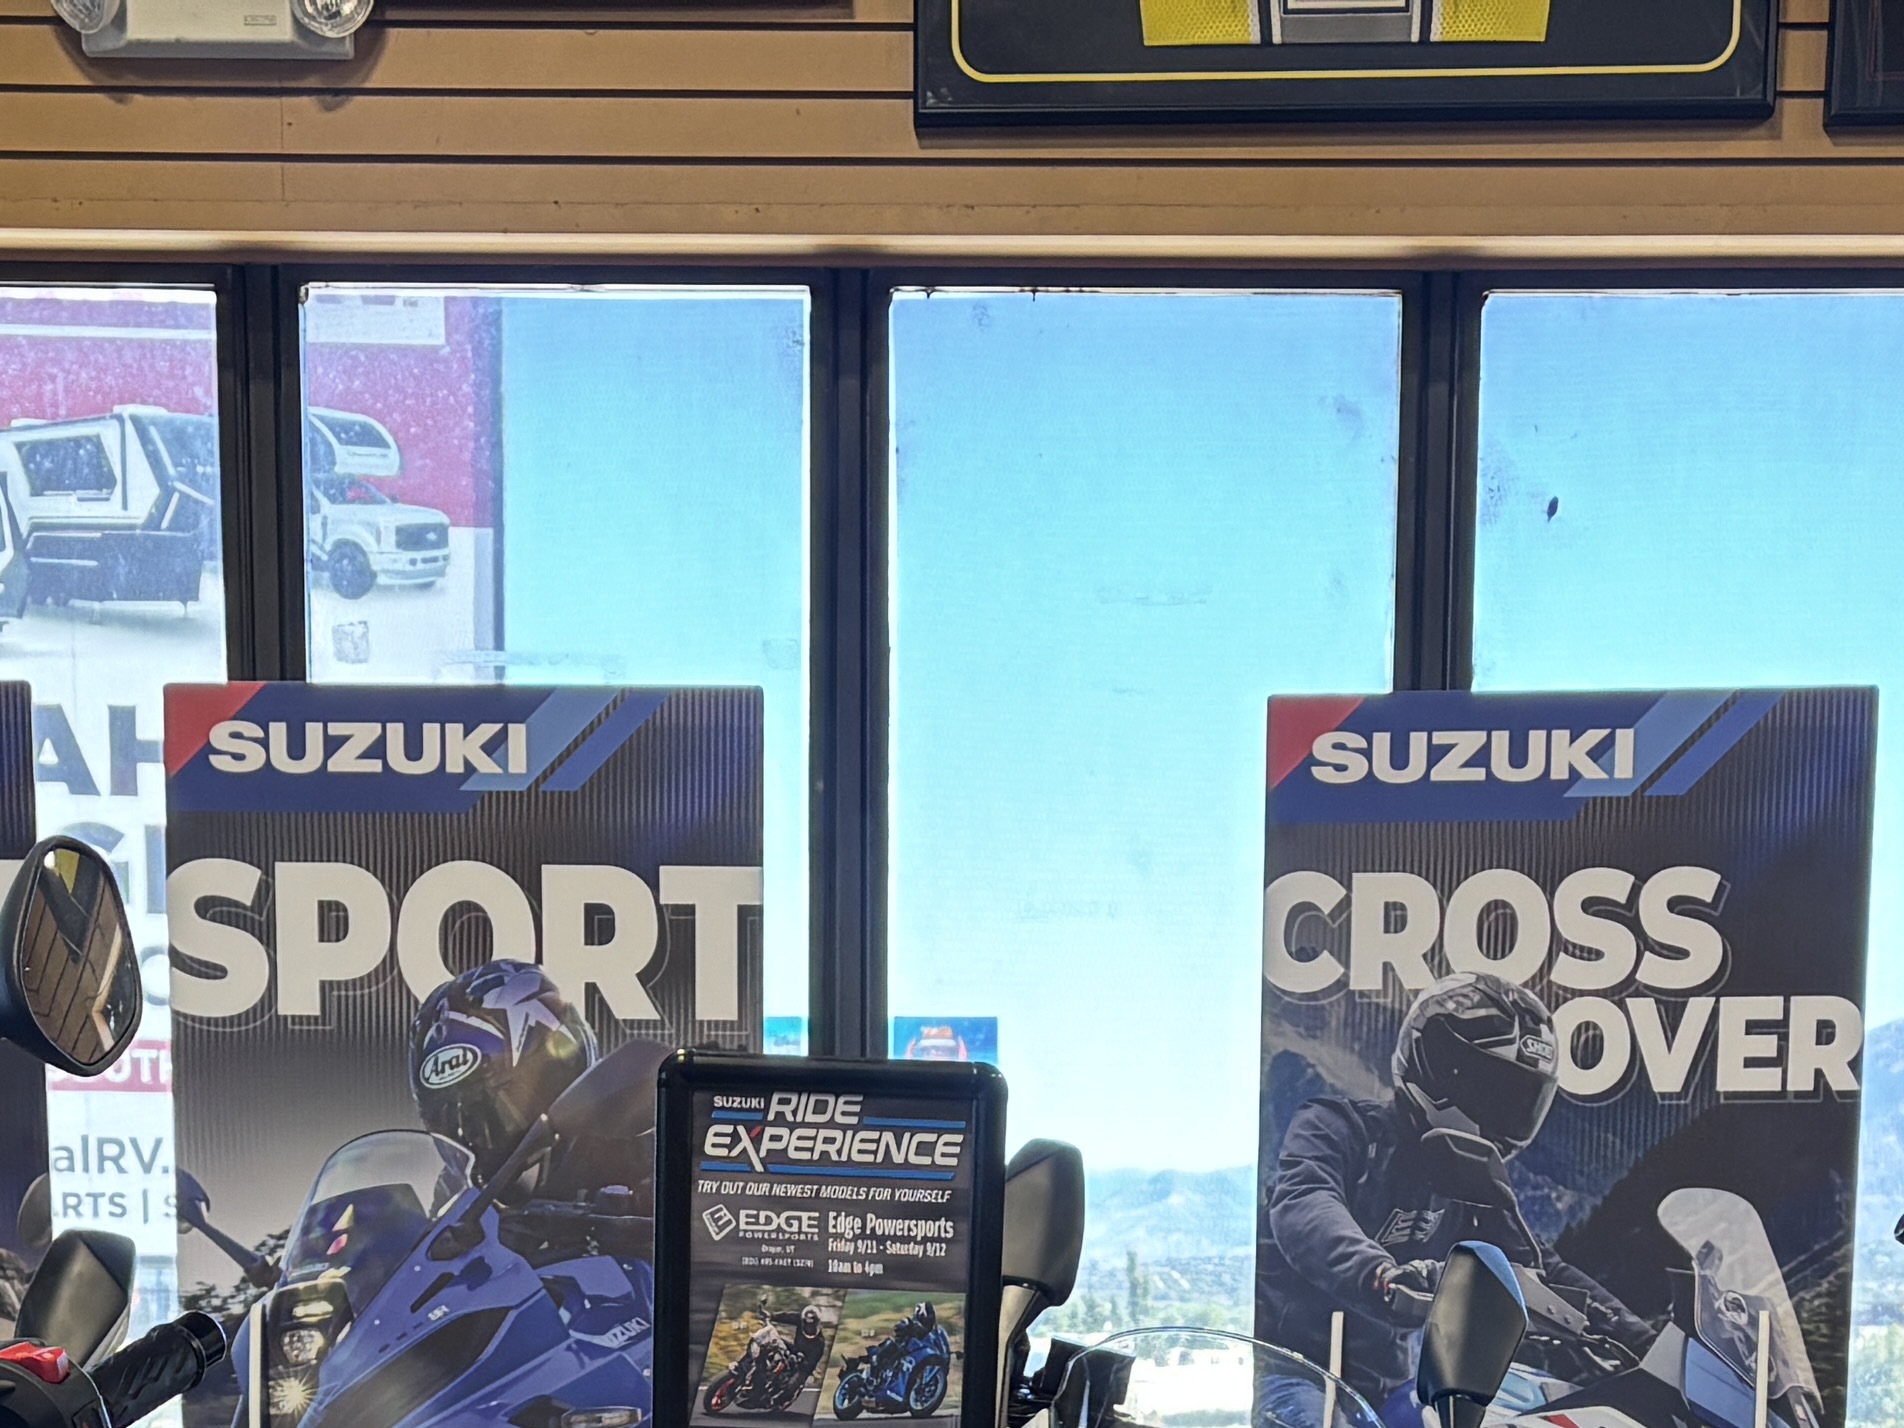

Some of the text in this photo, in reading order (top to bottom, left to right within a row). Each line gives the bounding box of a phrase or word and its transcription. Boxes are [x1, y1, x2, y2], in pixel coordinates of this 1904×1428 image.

[208, 720, 527, 774] SUZUKI
[1310, 728, 1636, 784] SUZUKI
[166, 858, 764, 1020] SPORT
[1264, 866, 1723, 993] CROSS
[1557, 996, 1862, 1095] OVER
[713, 1092, 864, 1125] SUZUKI RIDE
[704, 1124, 965, 1173] EXPERIENCE
[53, 1192, 127, 1219] RTS
[697, 1180, 952, 1203] TRY OUT OUR NEWEST MODELS FOR YOURSELF
[738, 1231, 819, 1241] POWERSPORTS
[739, 1209, 954, 1241] EDGE Edge Powersports
[828, 1238, 855, 1256] Friday
[885, 1240, 924, 1259] Saturday
